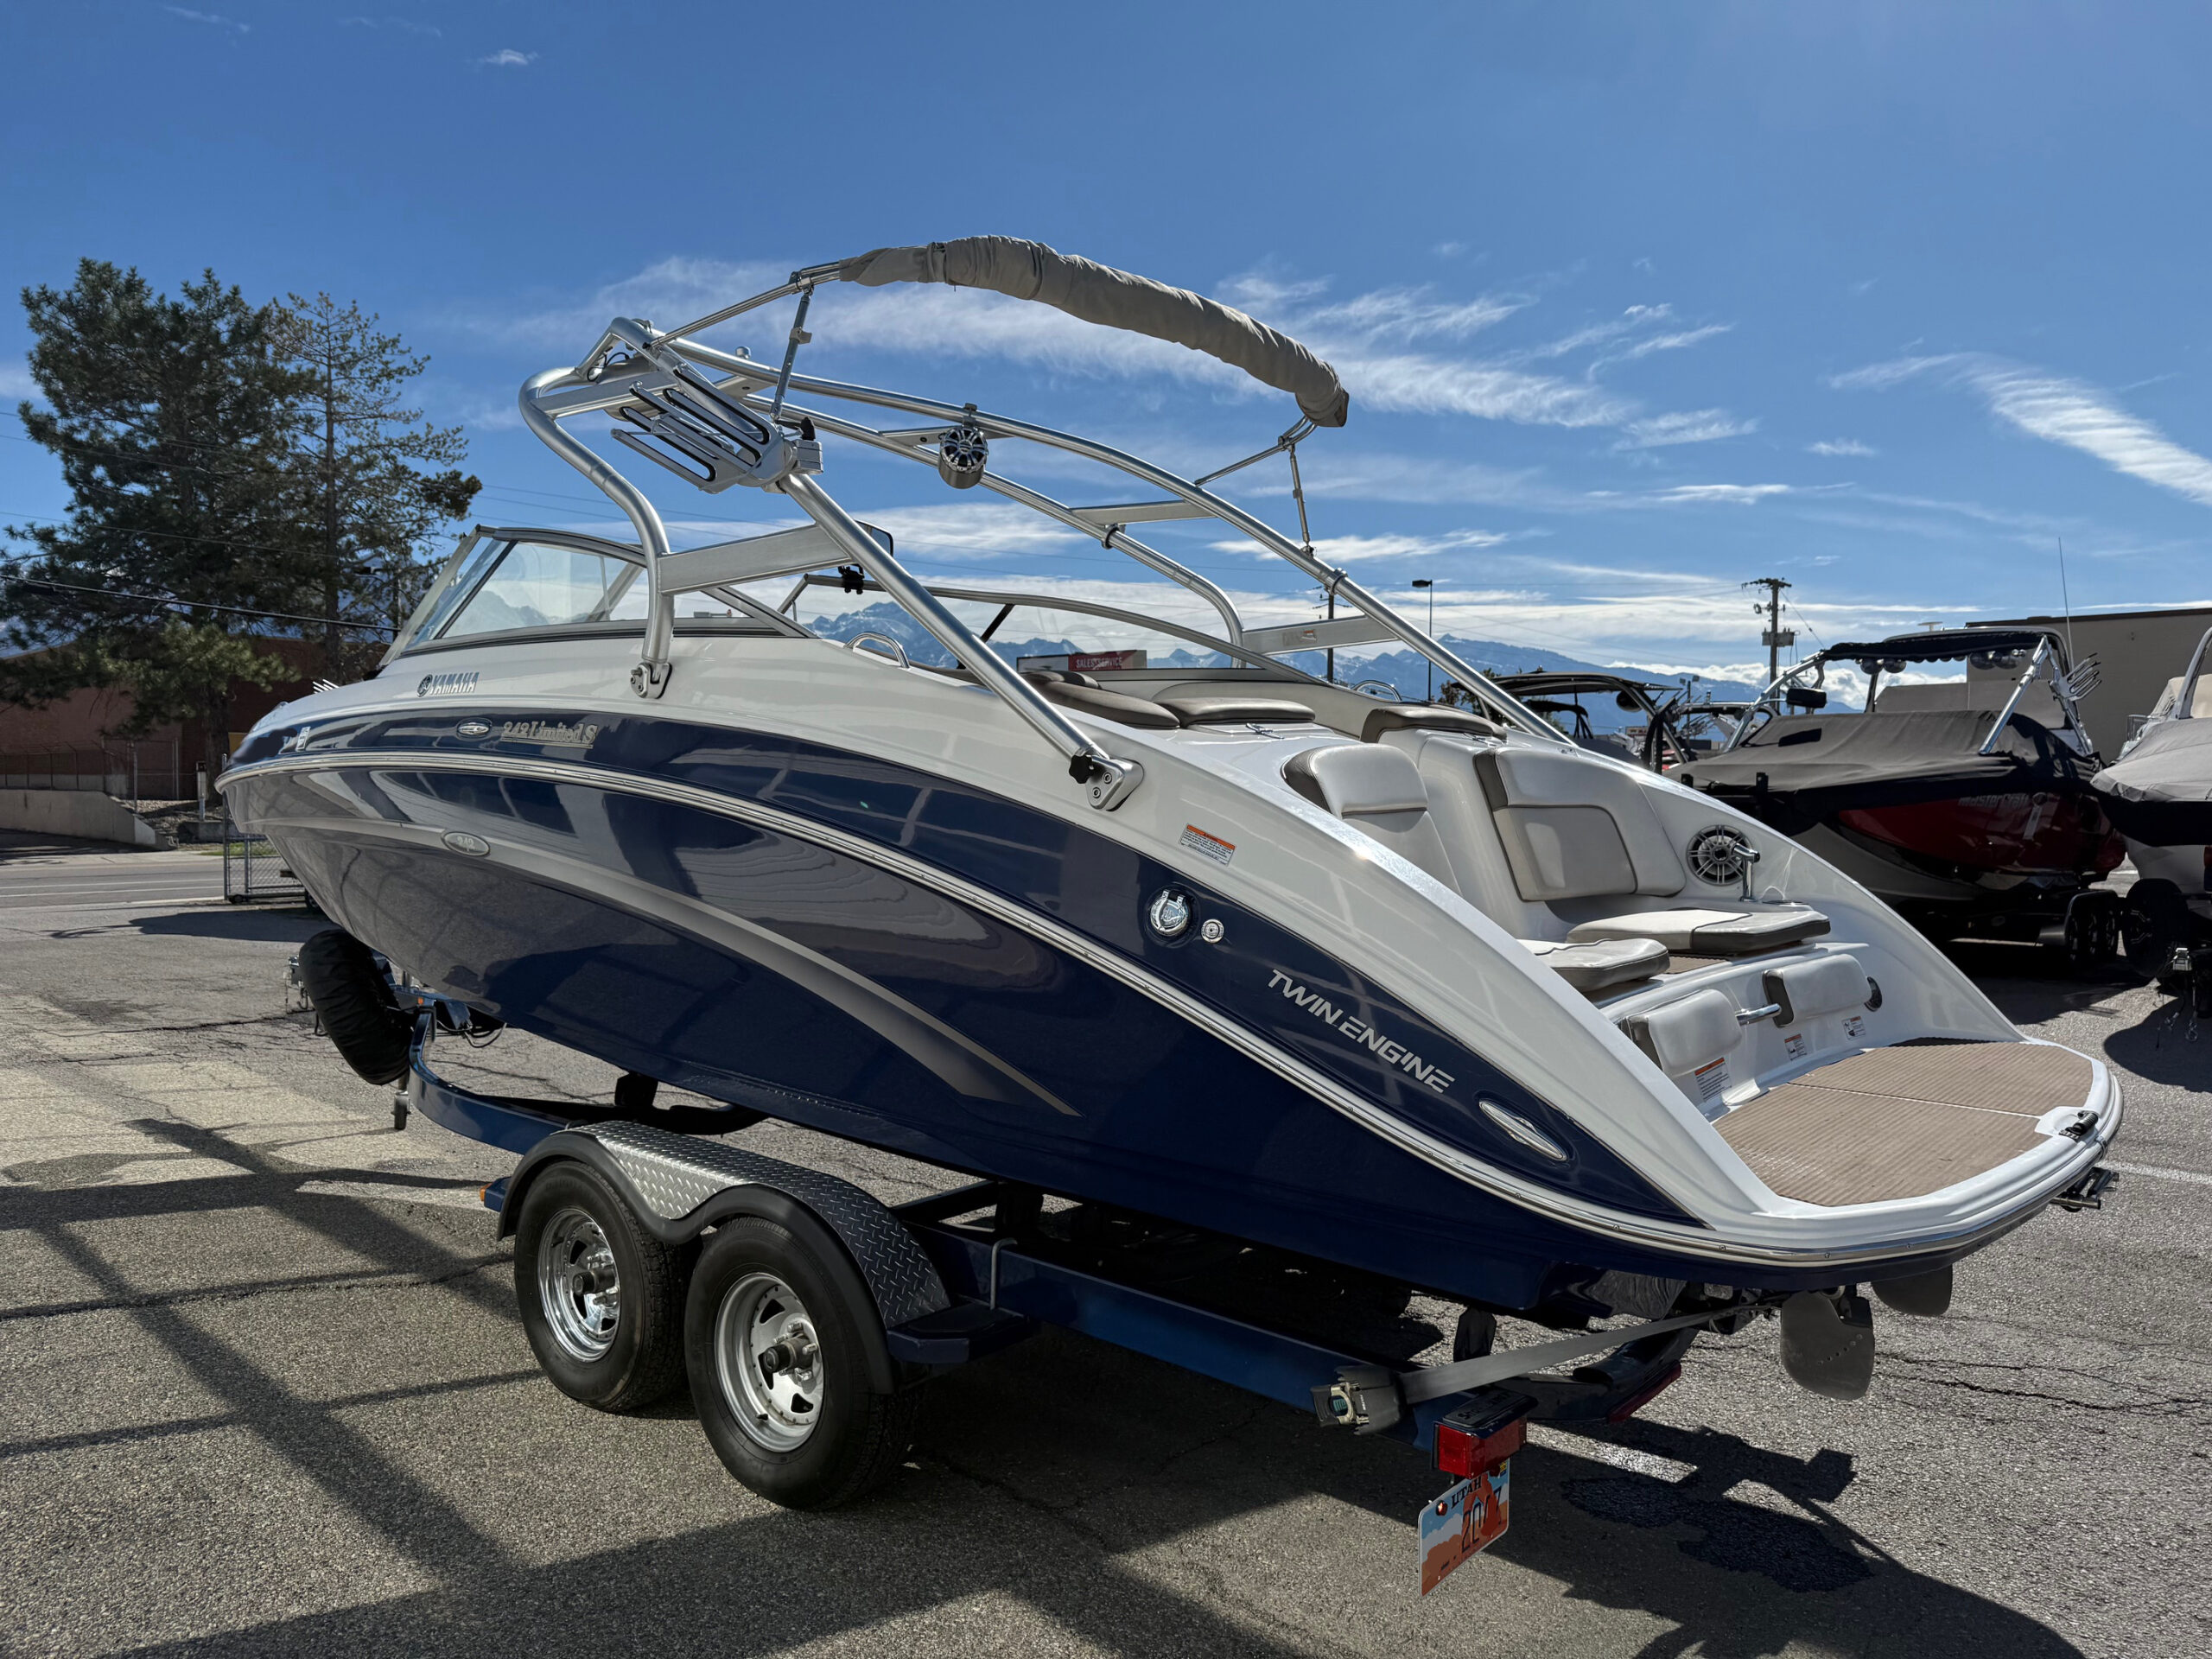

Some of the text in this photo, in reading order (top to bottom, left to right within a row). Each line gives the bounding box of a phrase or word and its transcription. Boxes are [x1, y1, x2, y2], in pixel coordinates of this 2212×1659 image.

[1076, 658, 1095, 669] SALES
[429, 671, 480, 695] YAMAHA
[502, 720, 598, 744] 242 Limited S
[1268, 969, 1455, 1094] TWIN ENGINE
[1451, 1475, 1482, 1510] UTAH
